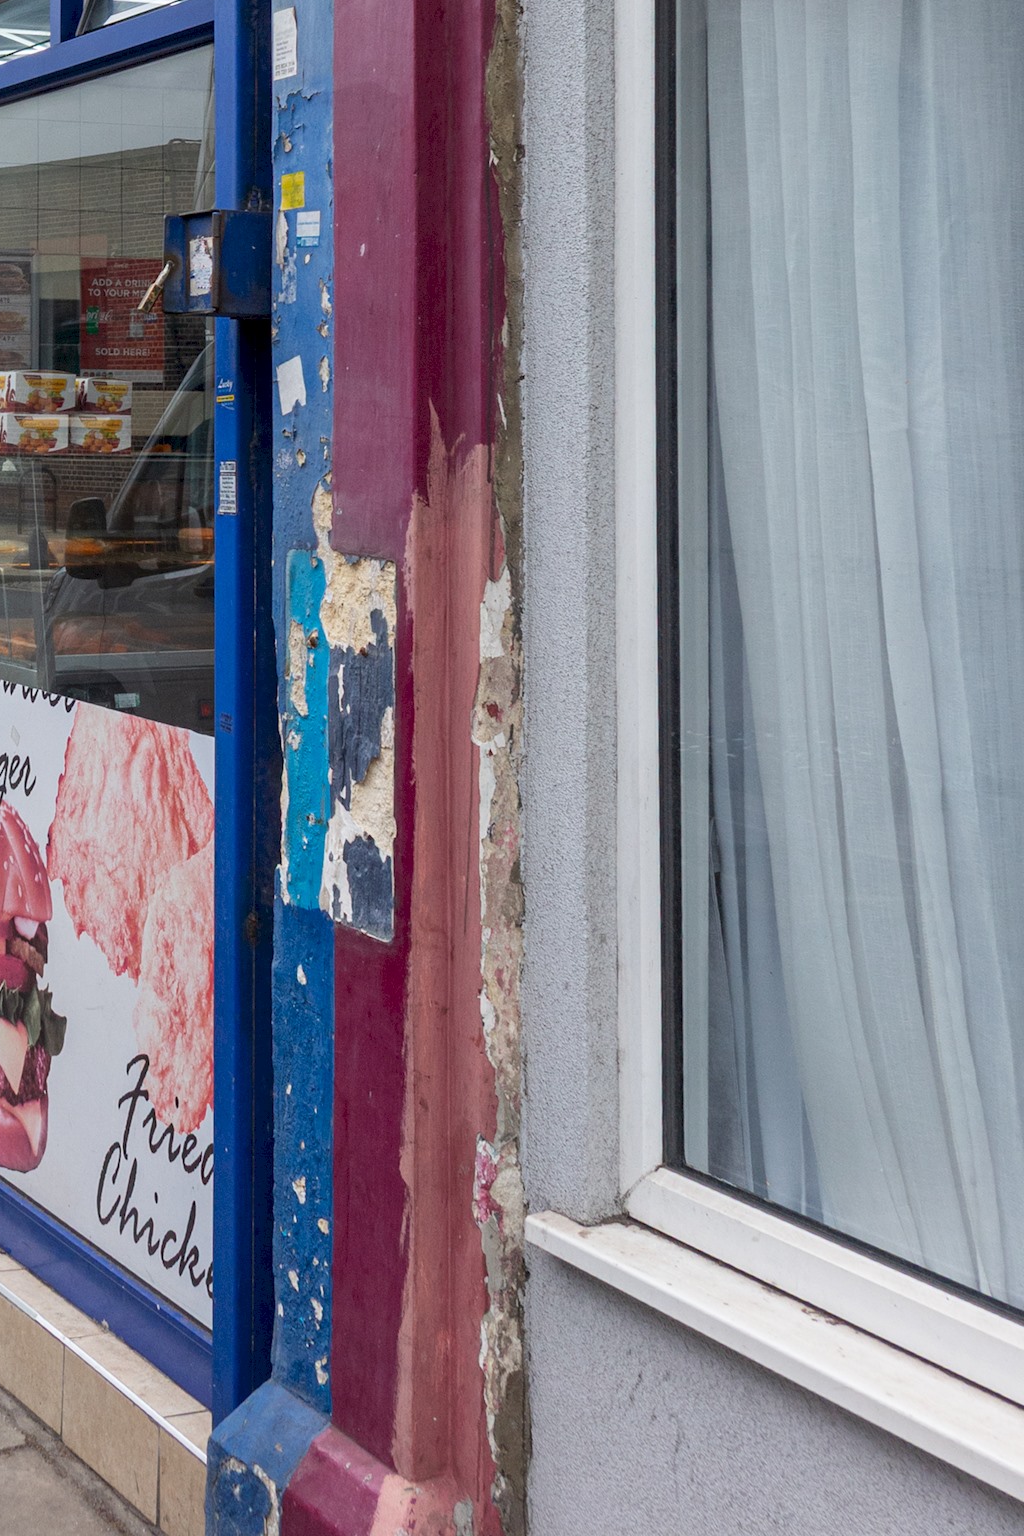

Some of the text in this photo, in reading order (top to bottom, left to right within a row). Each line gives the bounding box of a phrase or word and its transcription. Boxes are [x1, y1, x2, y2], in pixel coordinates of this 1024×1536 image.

[92, 278, 113, 287] ADD
[115, 279, 123, 287] A
[88, 289, 146, 298] TO YOUR ME
[96, 348, 151, 356] SOLD HERE!
